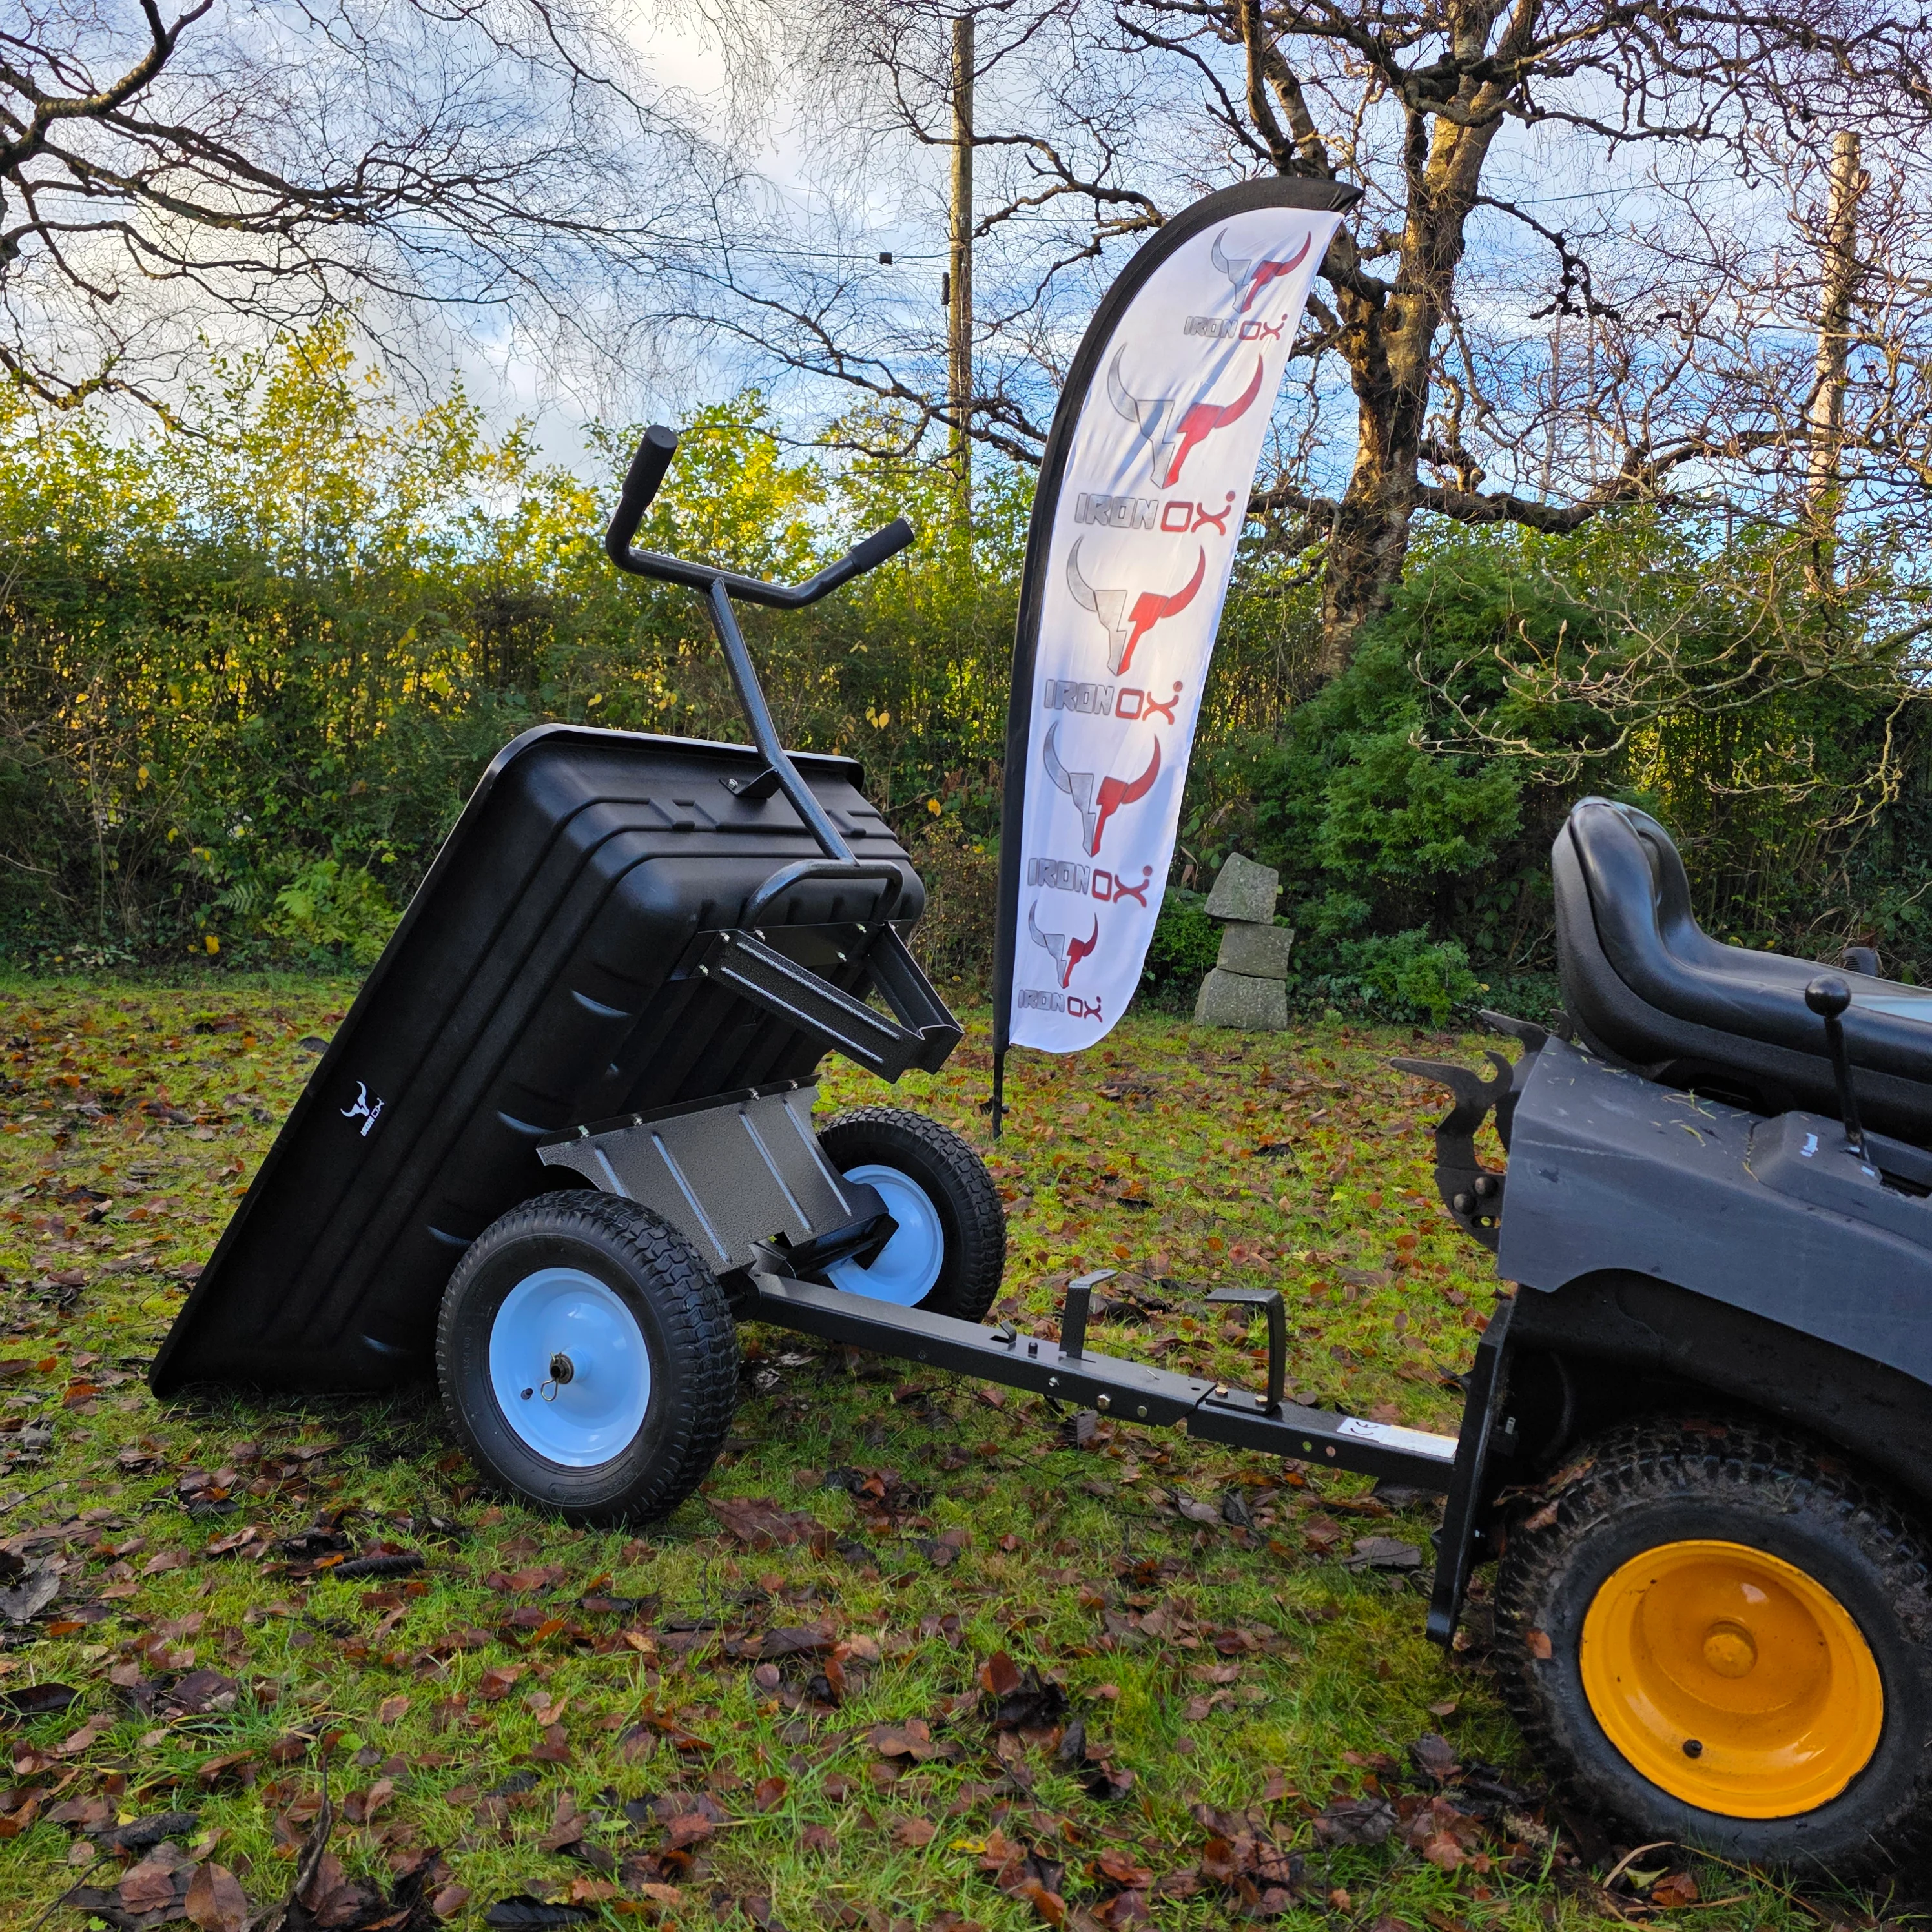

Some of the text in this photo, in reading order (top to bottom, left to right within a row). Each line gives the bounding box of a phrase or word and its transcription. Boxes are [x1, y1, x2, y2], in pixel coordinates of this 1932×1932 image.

[1183, 316, 1238, 338] IRON
[1074, 492, 1159, 530] IRON
[1043, 679, 1115, 715] IRON
[1027, 858, 1091, 896] IRON
[1018, 989, 1065, 1013] IRON
[360, 1115, 375, 1137] IRON
